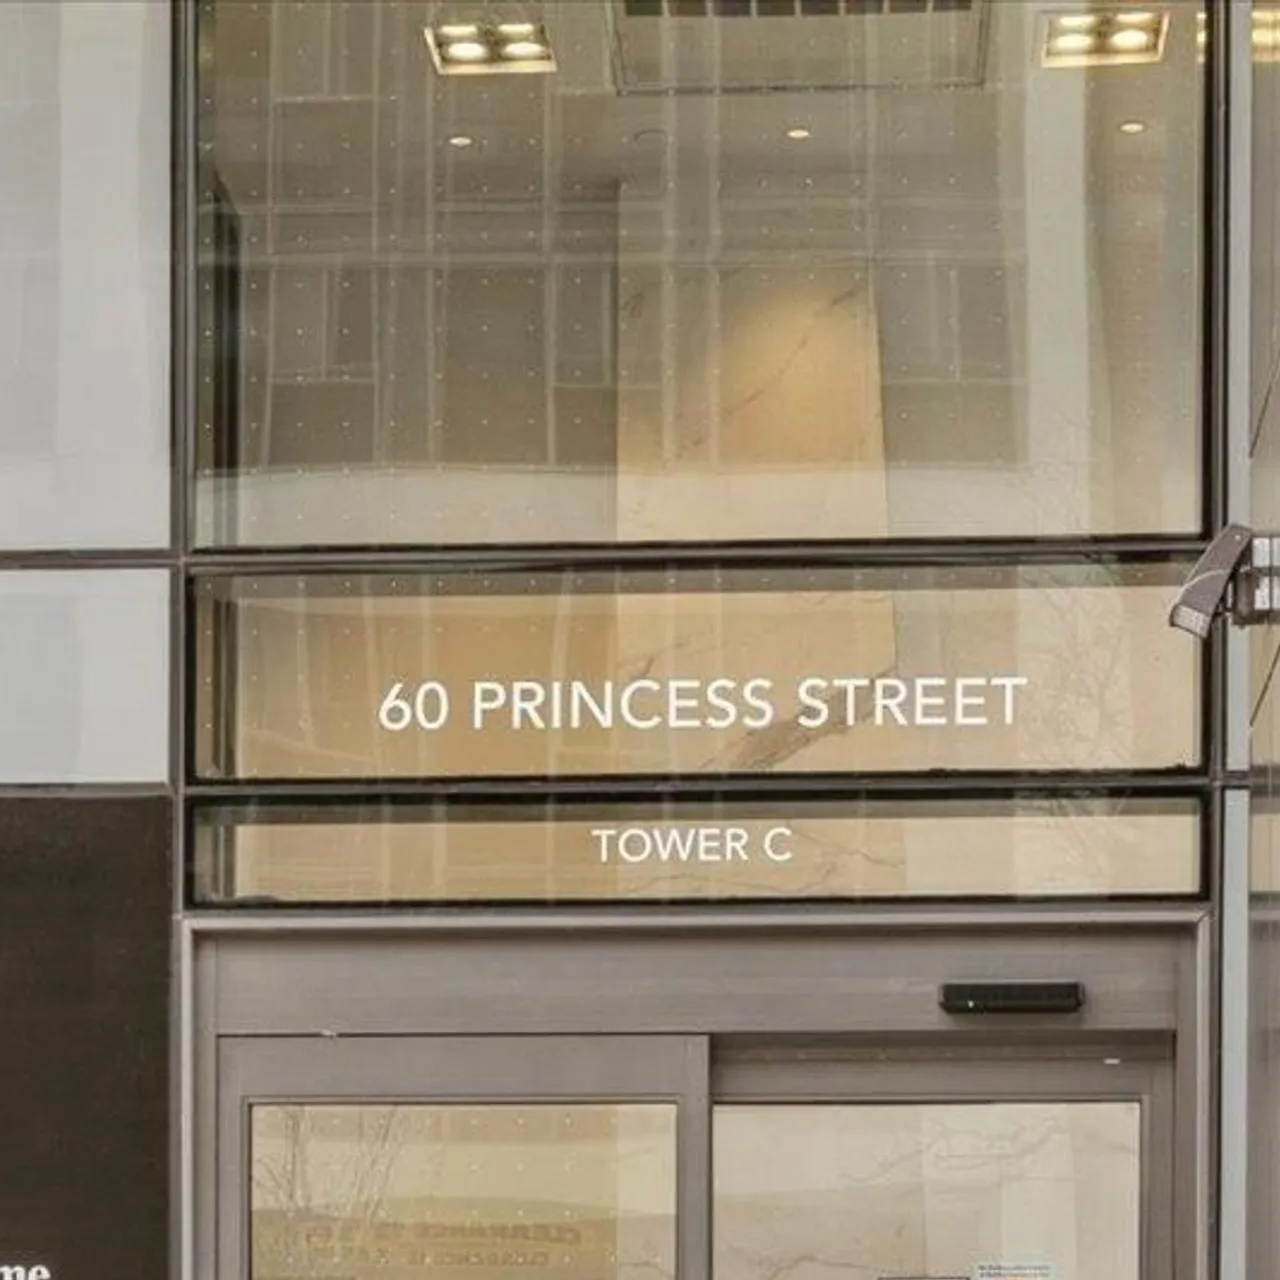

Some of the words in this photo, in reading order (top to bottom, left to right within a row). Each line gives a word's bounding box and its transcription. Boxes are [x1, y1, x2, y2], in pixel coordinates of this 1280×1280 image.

[378, 681, 449, 731] 60
[472, 679, 774, 729] PRINCESS
[797, 676, 1028, 728] STREET
[592, 828, 748, 863] TOWER
[763, 827, 793, 862] C
